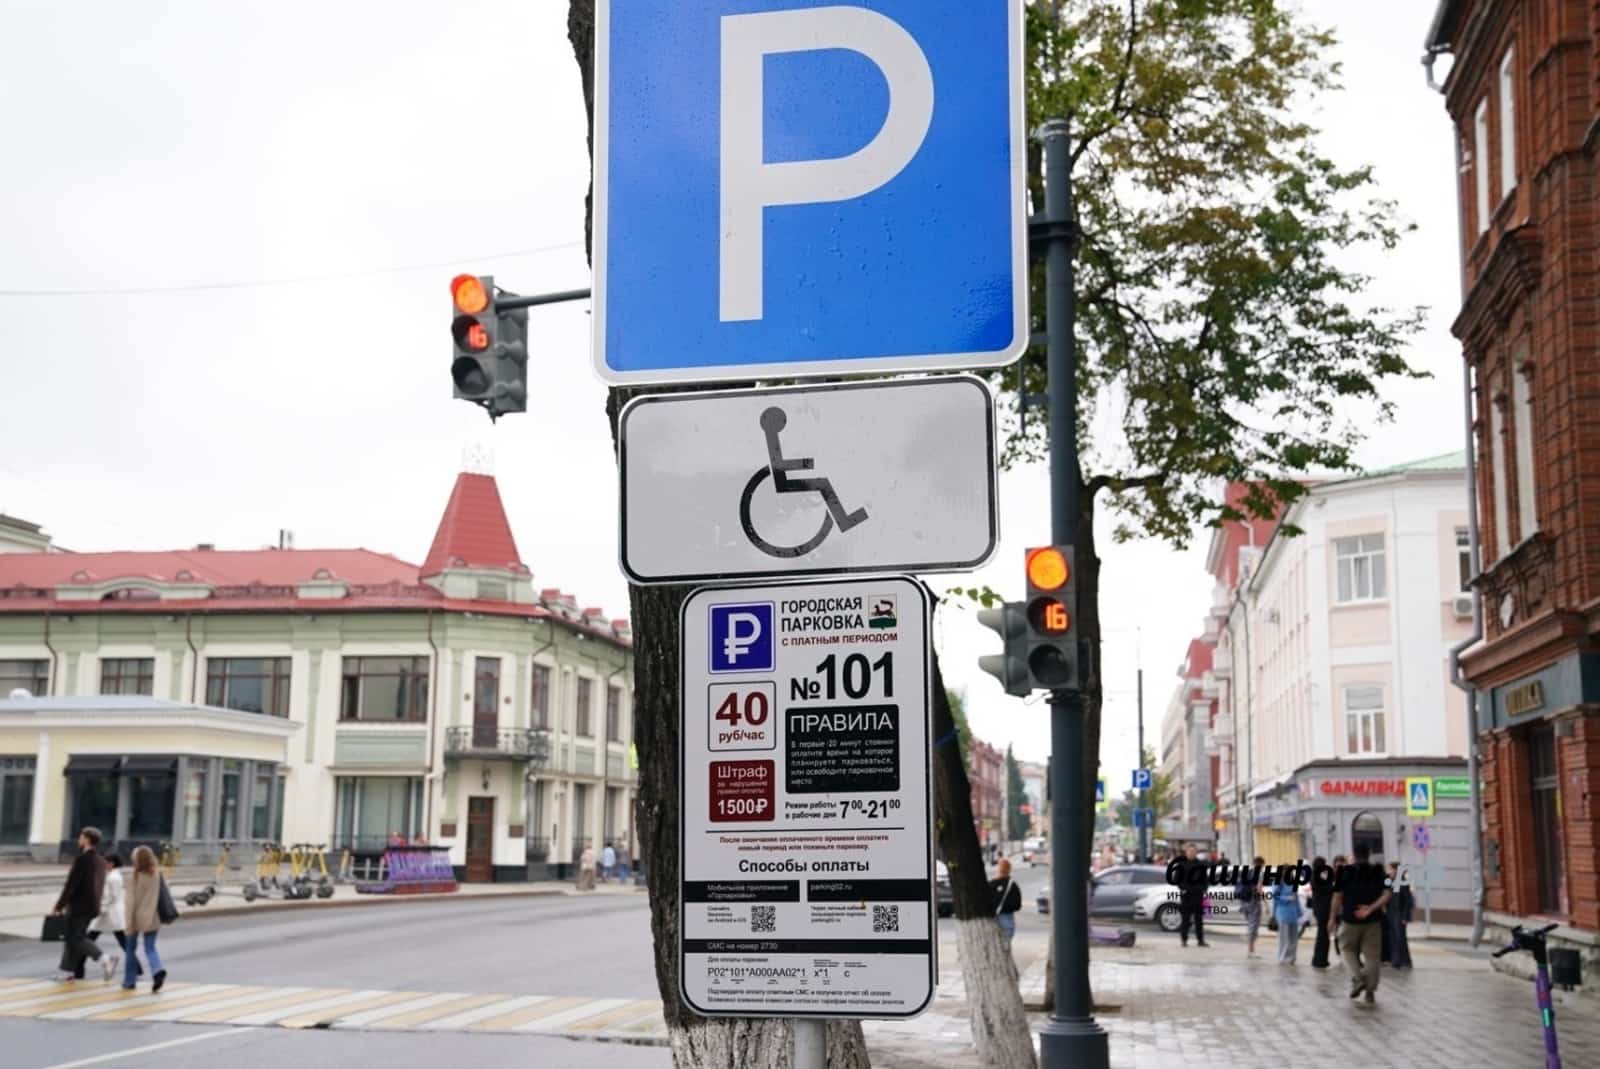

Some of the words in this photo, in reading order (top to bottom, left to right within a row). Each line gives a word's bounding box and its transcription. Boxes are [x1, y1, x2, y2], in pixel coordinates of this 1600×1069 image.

[720, 6, 935, 322] P
[781, 597, 862, 614] ГОРОДСКАЯ
[781, 614, 865, 632] ПАРКОВКА
[1046, 603, 1068, 630] 16
[791, 635, 840, 646] ПЛАТНЫМ
[842, 632, 898, 643] ПЕРИОДОМ
[715, 691, 769, 726] 40
[790, 712, 894, 733] ПРАВИЛА
[718, 730, 765, 744] руб/час
[717, 765, 768, 780] Штраф
[1135, 770, 1149, 783] P
[738, 859, 807, 873] Способы
[811, 860, 870, 873] оплаты
